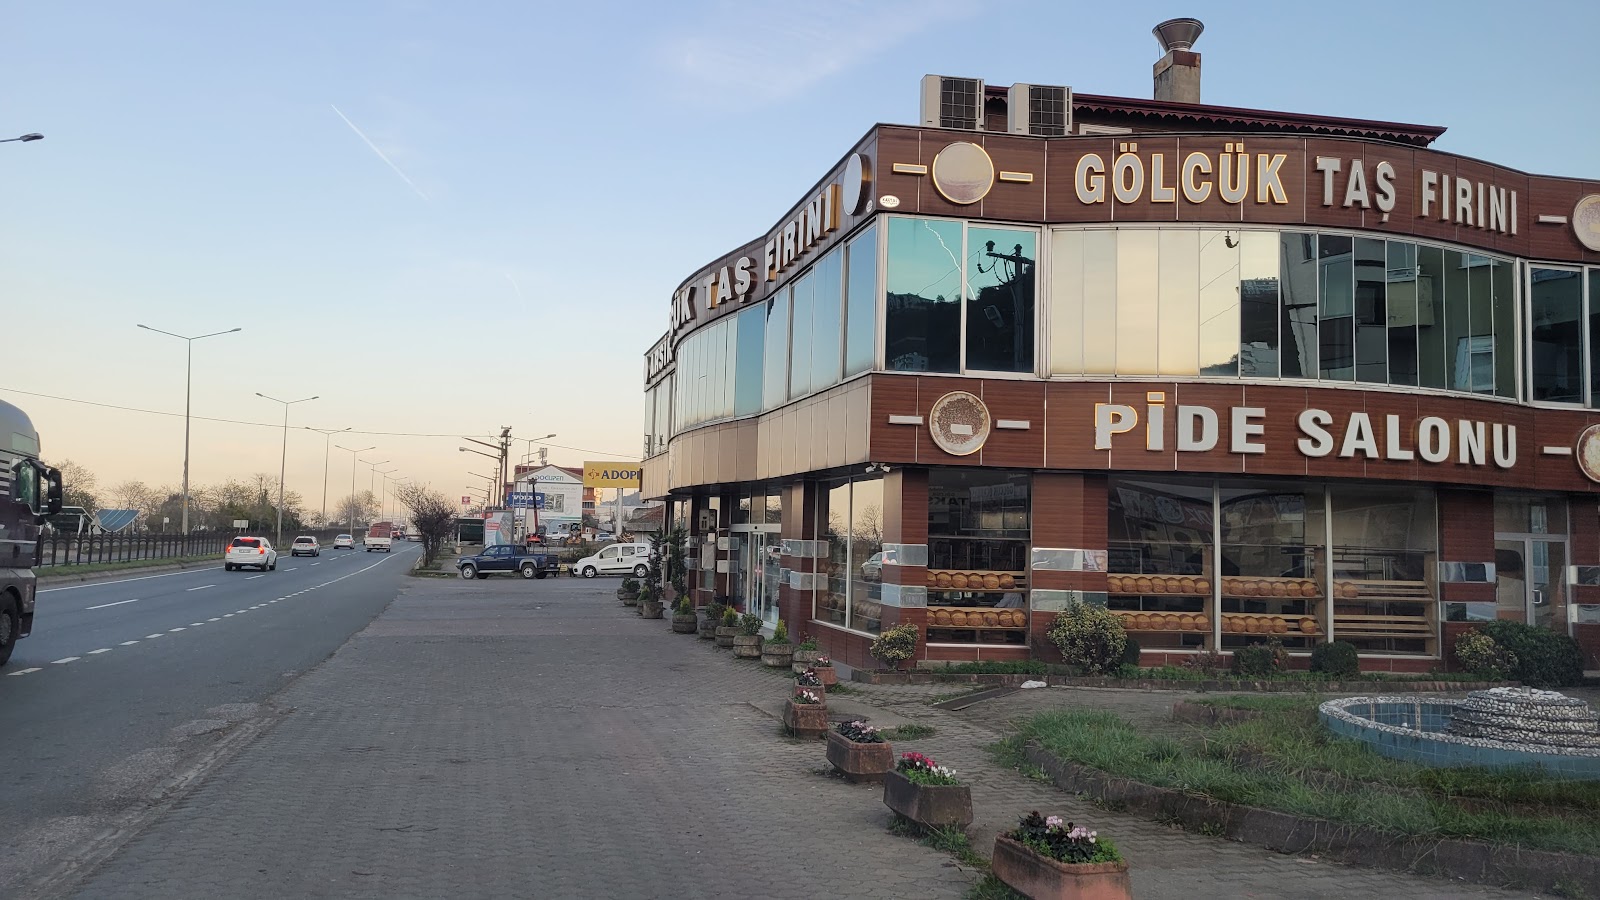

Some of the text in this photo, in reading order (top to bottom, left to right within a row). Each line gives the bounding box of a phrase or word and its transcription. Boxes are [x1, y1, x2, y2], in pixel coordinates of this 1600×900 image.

[1074, 142, 1518, 235] GÖLCÜK TAŞ FIRINI
[703, 256, 755, 309] TAŞ
[765, 184, 840, 282] FIRINI
[1094, 390, 1518, 469] PİDE SALONU
